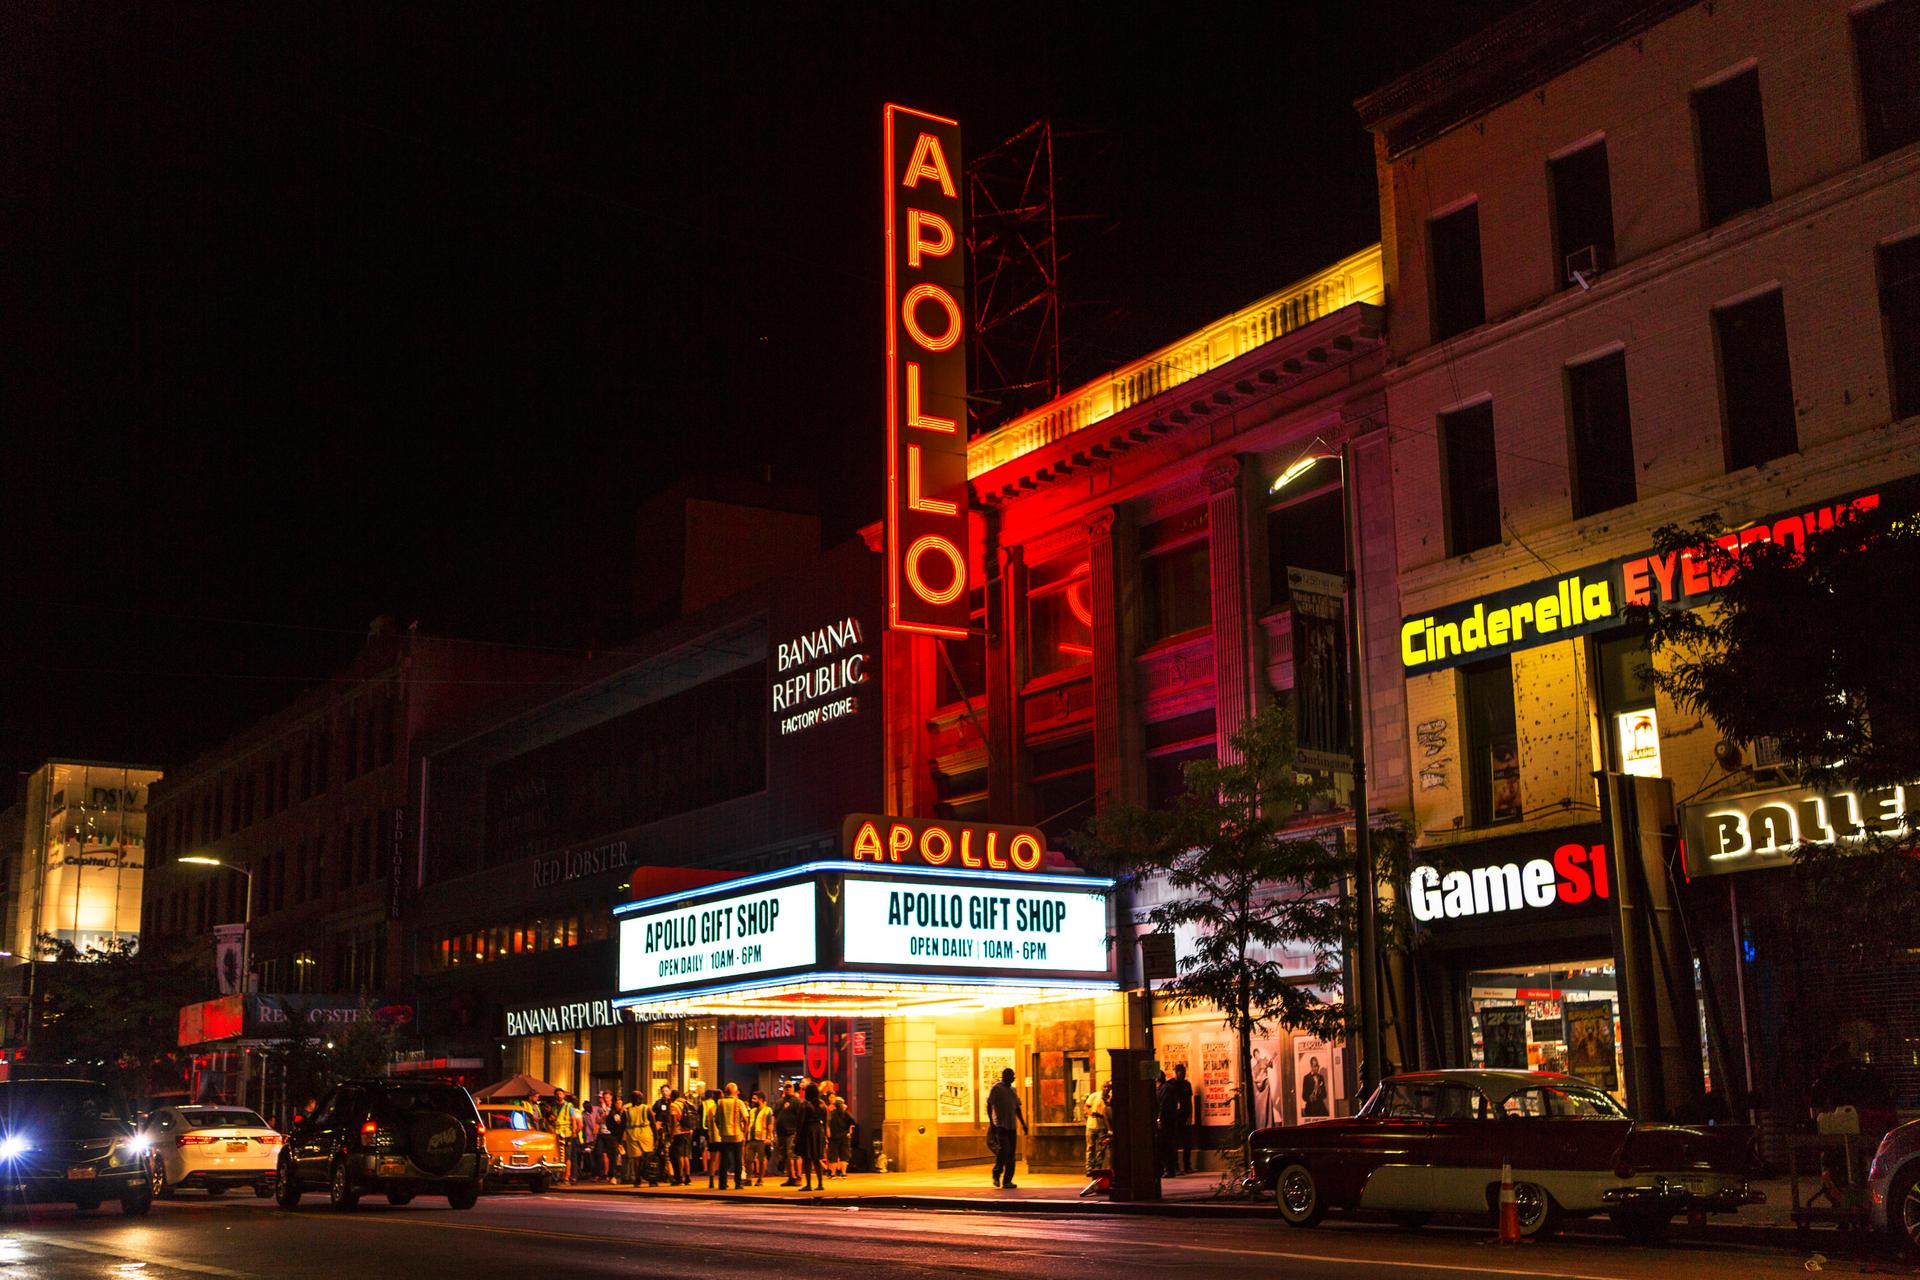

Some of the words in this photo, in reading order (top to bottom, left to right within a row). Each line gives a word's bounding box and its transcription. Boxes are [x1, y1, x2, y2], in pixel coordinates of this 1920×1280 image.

[901, 131, 968, 605] APOLLO
[778, 617, 860, 672] BANANA
[1401, 576, 1612, 667] Cinderella
[773, 654, 864, 712] REPUBLIC
[781, 707, 820, 735] FACTORY
[822, 697, 853, 722] STORE
[853, 821, 1040, 870] APOLLO
[1703, 784, 1920, 859] BALLE
[532, 858, 560, 889] RED
[564, 841, 628, 881] LOBSTER
[1409, 843, 1610, 922] GameSt
[645, 914, 696, 954] APOLLO
[701, 907, 733, 944] GIFT
[737, 898, 779, 938] SHOP
[888, 891, 963, 928] APOLLO
[969, 895, 1011, 930] GIFT
[1016, 897, 1066, 933] SHOP
[659, 957, 679, 977] OPEN
[681, 953, 703, 974] DAILY
[711, 949, 734, 969] 10AM
[742, 944, 762, 965] 6PM
[910, 936, 939, 956] OPEN
[942, 938, 973, 958] DAILY
[983, 940, 1013, 959] 10AM
[1023, 941, 1047, 960] 6PM
[507, 1007, 560, 1037] BANANA
[718, 1020, 736, 1042] art
[736, 1015, 793, 1041] materials
